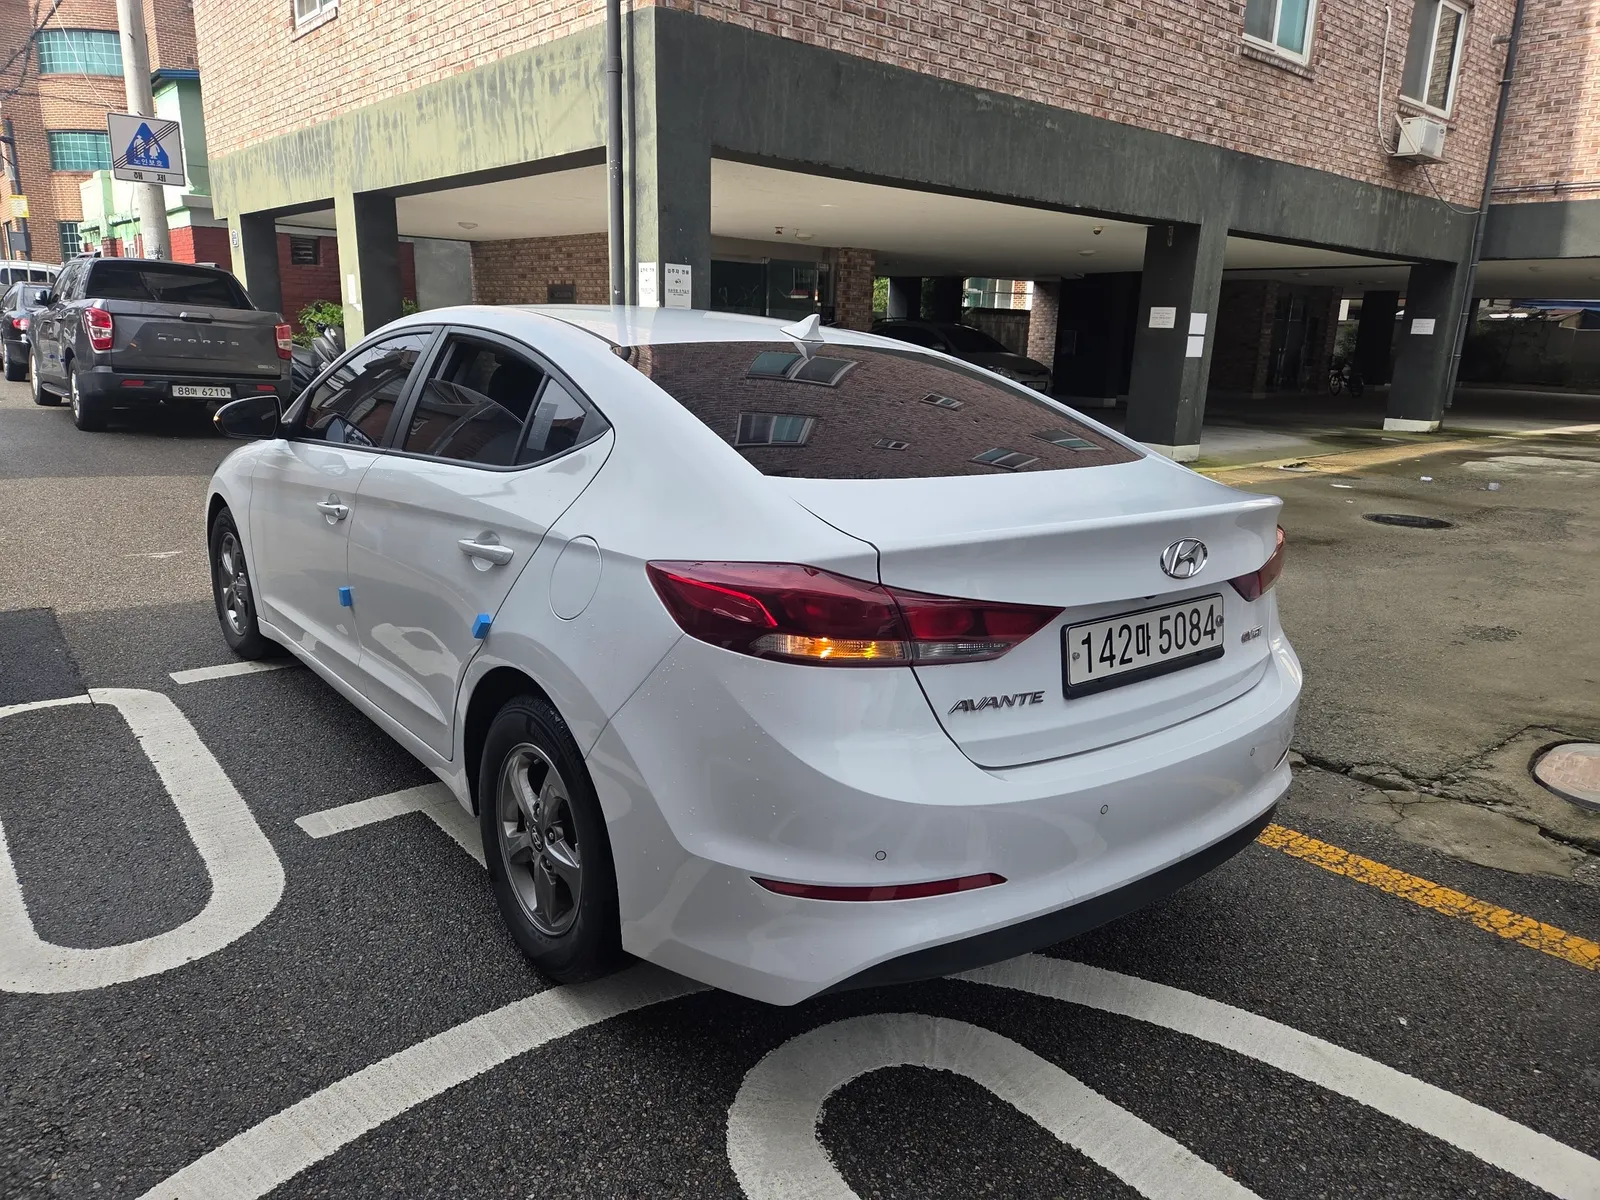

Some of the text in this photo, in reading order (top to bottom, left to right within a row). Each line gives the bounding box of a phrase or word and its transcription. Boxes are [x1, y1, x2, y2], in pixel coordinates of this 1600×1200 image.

[133, 158, 164, 167] 노인보호
[201, 387, 226, 397] 6210
[1081, 604, 1217, 674] 142마 5084
[947, 690, 1046, 715] AVANTE
